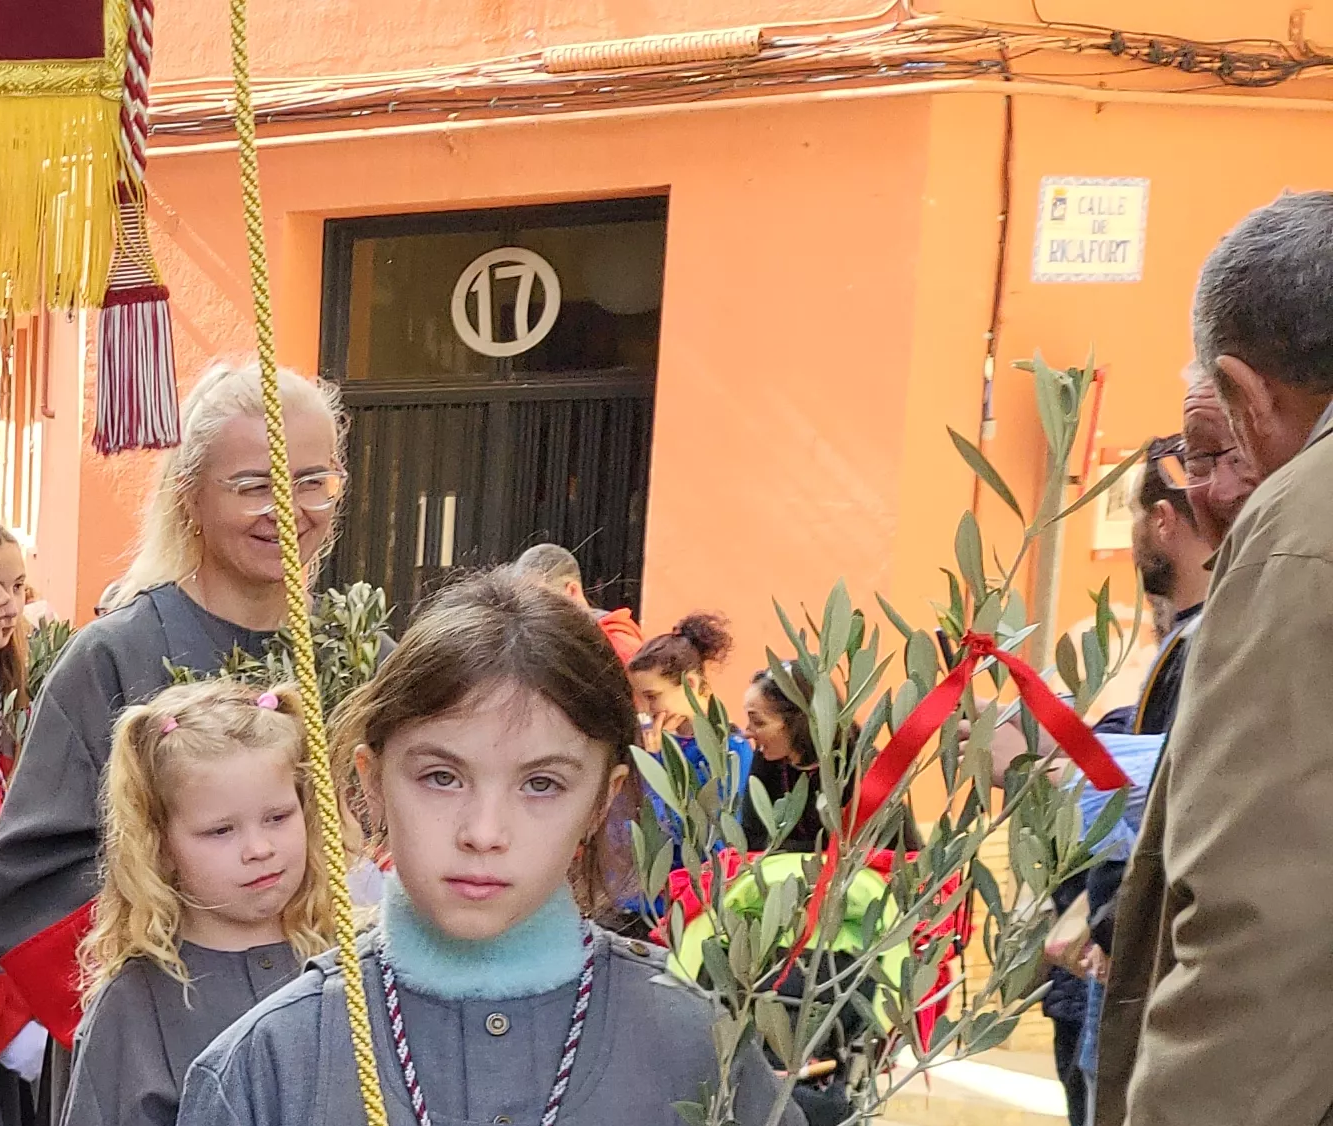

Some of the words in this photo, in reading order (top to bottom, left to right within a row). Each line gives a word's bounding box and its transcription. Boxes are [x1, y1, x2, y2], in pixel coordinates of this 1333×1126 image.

[1077, 196, 1127, 216] CALLE
[1091, 219, 1108, 235] DE
[1047, 239, 1132, 264] RICAFORT
[467, 259, 539, 346] 17
